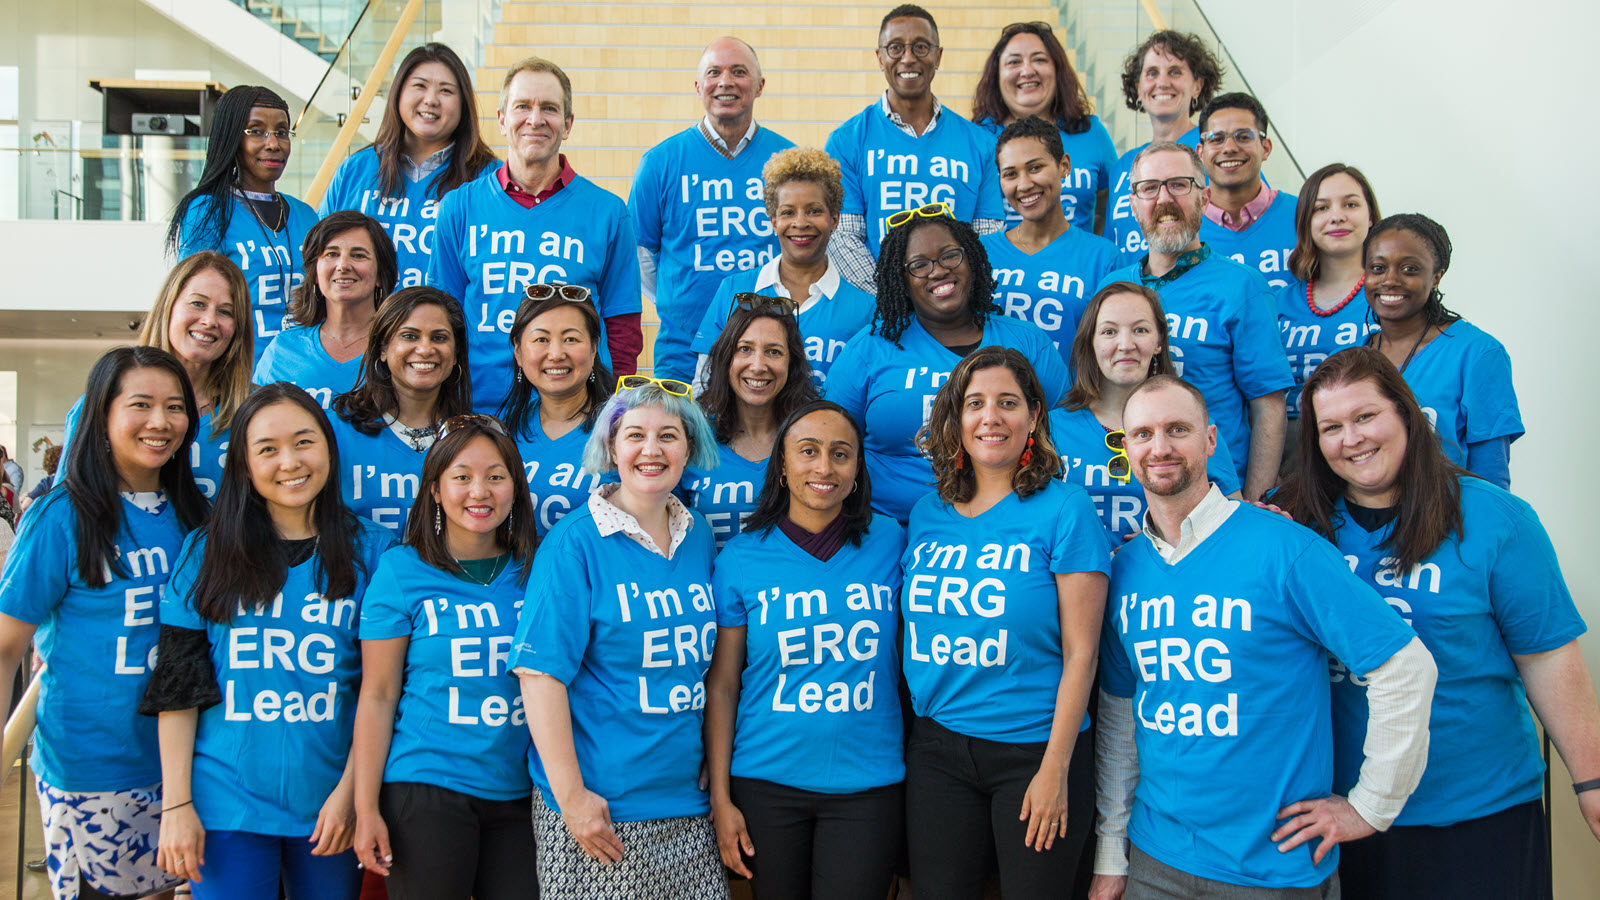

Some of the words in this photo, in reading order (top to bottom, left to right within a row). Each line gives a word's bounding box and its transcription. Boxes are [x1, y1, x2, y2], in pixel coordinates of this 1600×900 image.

[867, 149, 918, 176] I'm
[929, 156, 969, 183] an
[360, 189, 410, 217] I'm
[420, 199, 440, 219] a
[682, 173, 733, 203] I'm
[745, 177, 765, 201] a
[880, 181, 956, 214] ERG
[696, 206, 775, 237] ERG
[235, 240, 292, 270] I'm
[469, 224, 526, 257] I'm
[538, 231, 585, 264] an
[258, 273, 305, 306] ER
[1037, 271, 1085, 300] an
[477, 303, 516, 334] Le
[992, 291, 1064, 331] RG
[1165, 313, 1209, 342] an
[804, 336, 847, 363] an
[353, 464, 420, 500] I'm
[549, 463, 602, 495] an
[691, 476, 754, 508] I'm
[910, 541, 968, 571] I'm
[976, 543, 1031, 573] an
[1375, 556, 1441, 594] an
[301, 592, 357, 630] an
[616, 582, 683, 623] I'm
[757, 586, 828, 625] I'm
[845, 583, 893, 612] an
[908, 574, 1006, 618] ERG
[1120, 592, 1175, 634] I'm
[1192, 594, 1252, 632] an
[423, 598, 500, 636] I'm
[229, 627, 336, 674] ERG
[451, 636, 515, 677] ER
[642, 621, 717, 668] ERG
[777, 619, 880, 668] ERG
[909, 621, 1008, 667] Lead
[1133, 637, 1232, 683] ERG
[225, 680, 338, 723] Lead
[449, 687, 528, 727] Lea
[638, 675, 708, 714] Lea
[772, 671, 876, 713] Lead
[1138, 690, 1238, 736] Lead
